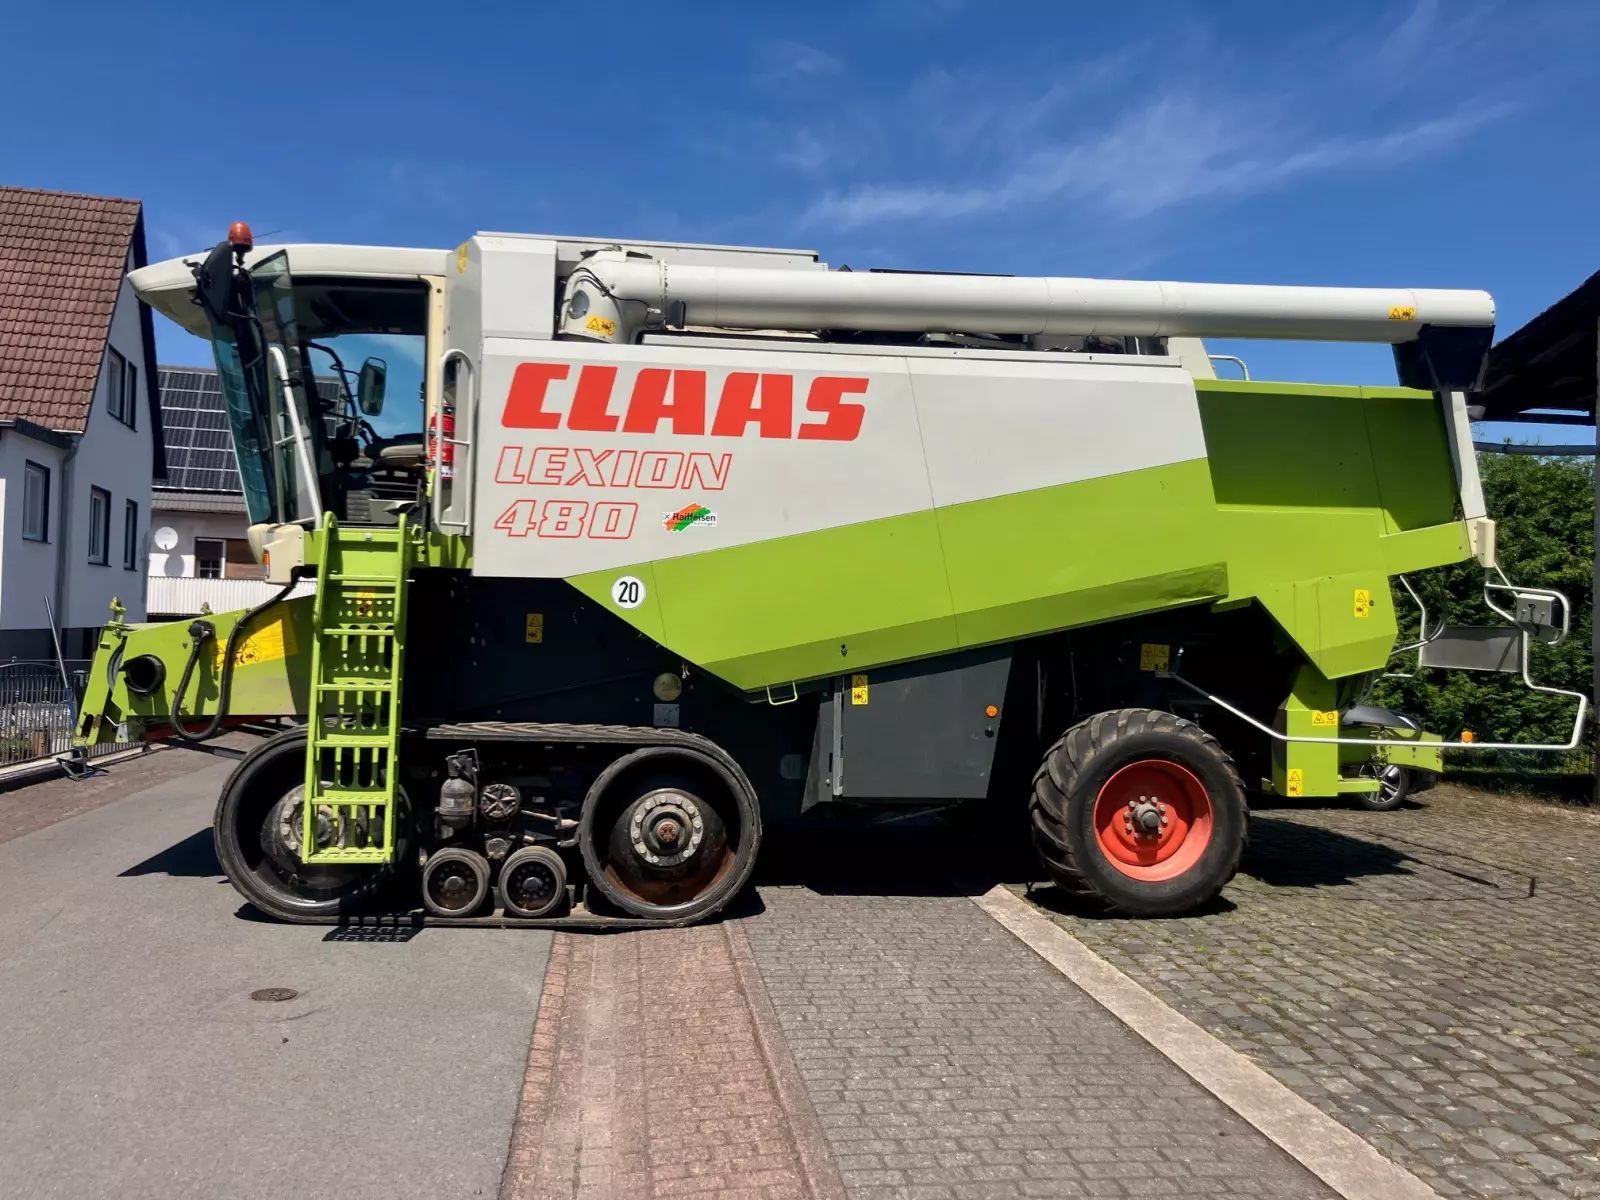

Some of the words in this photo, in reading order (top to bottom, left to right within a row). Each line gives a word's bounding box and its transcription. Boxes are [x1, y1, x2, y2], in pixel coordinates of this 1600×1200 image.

[501, 362, 869, 442] CLAAS
[494, 446, 733, 491] LEXION
[493, 499, 639, 540] 480
[673, 512, 716, 522] Raiffeisen
[618, 581, 639, 604] 20
